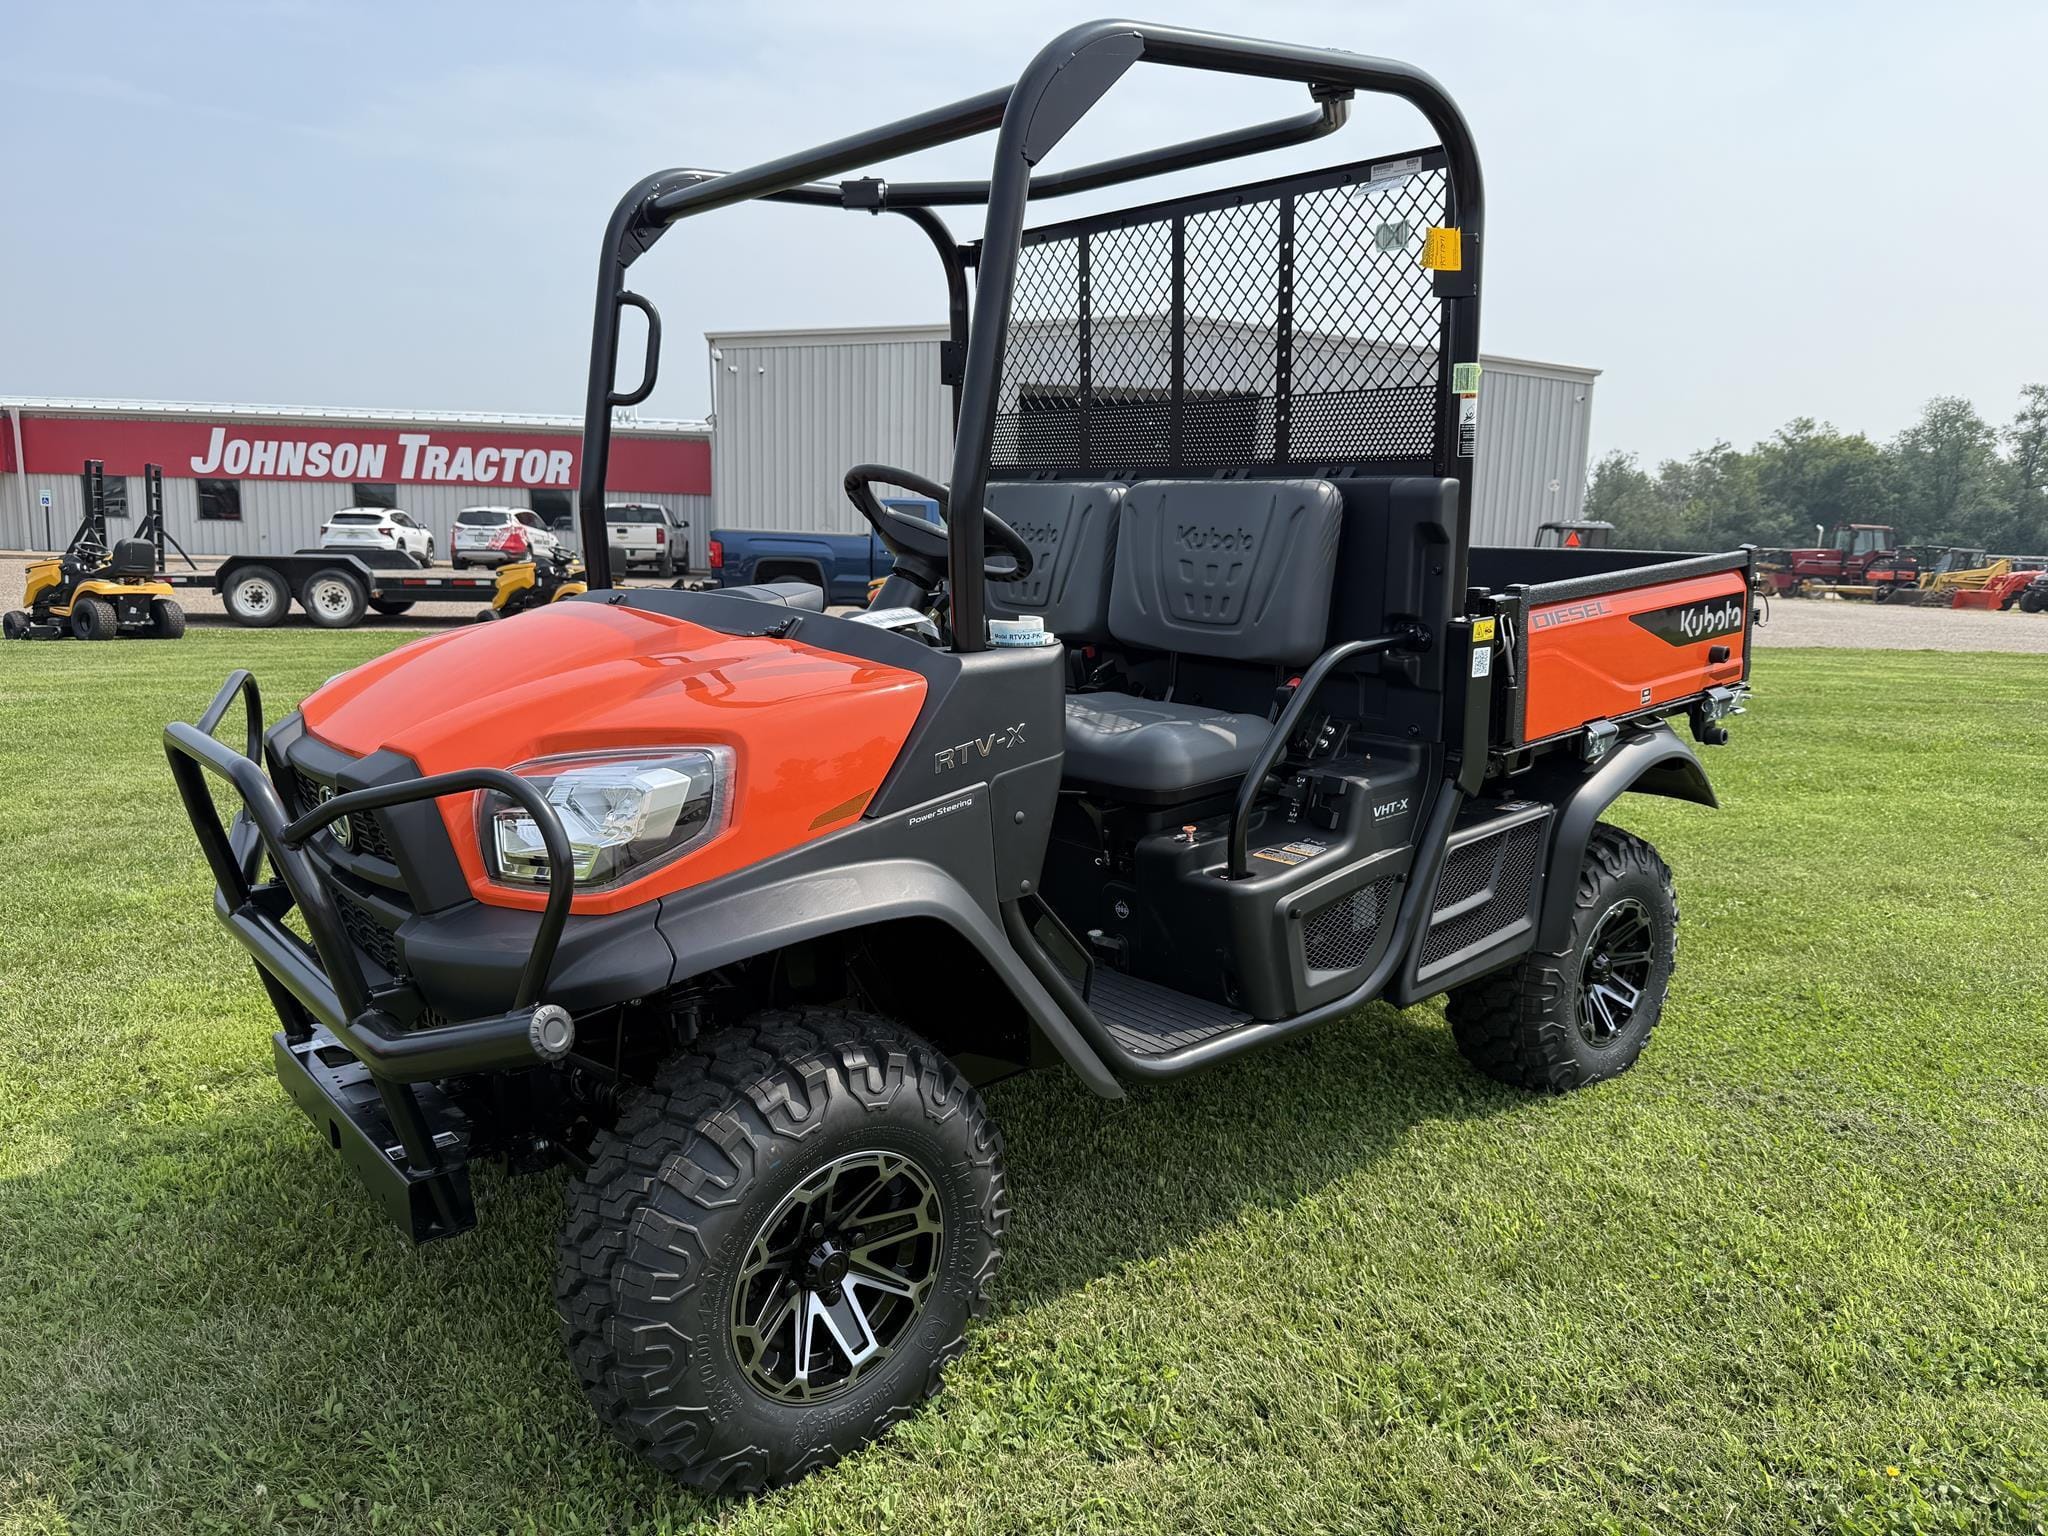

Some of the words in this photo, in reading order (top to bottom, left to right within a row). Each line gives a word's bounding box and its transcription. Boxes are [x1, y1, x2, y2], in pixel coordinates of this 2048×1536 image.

[190, 427, 387, 478] JOHNSON
[398, 433, 573, 485] TRACTOR
[1176, 524, 1253, 552] Kubota
[1532, 602, 1613, 629] DIESEL
[1680, 600, 1741, 638] Kubota
[935, 723, 1026, 774] RTV-X
[909, 811, 937, 826] Power
[936, 798, 972, 816] Steering
[1373, 798, 1409, 817] VHT-X
